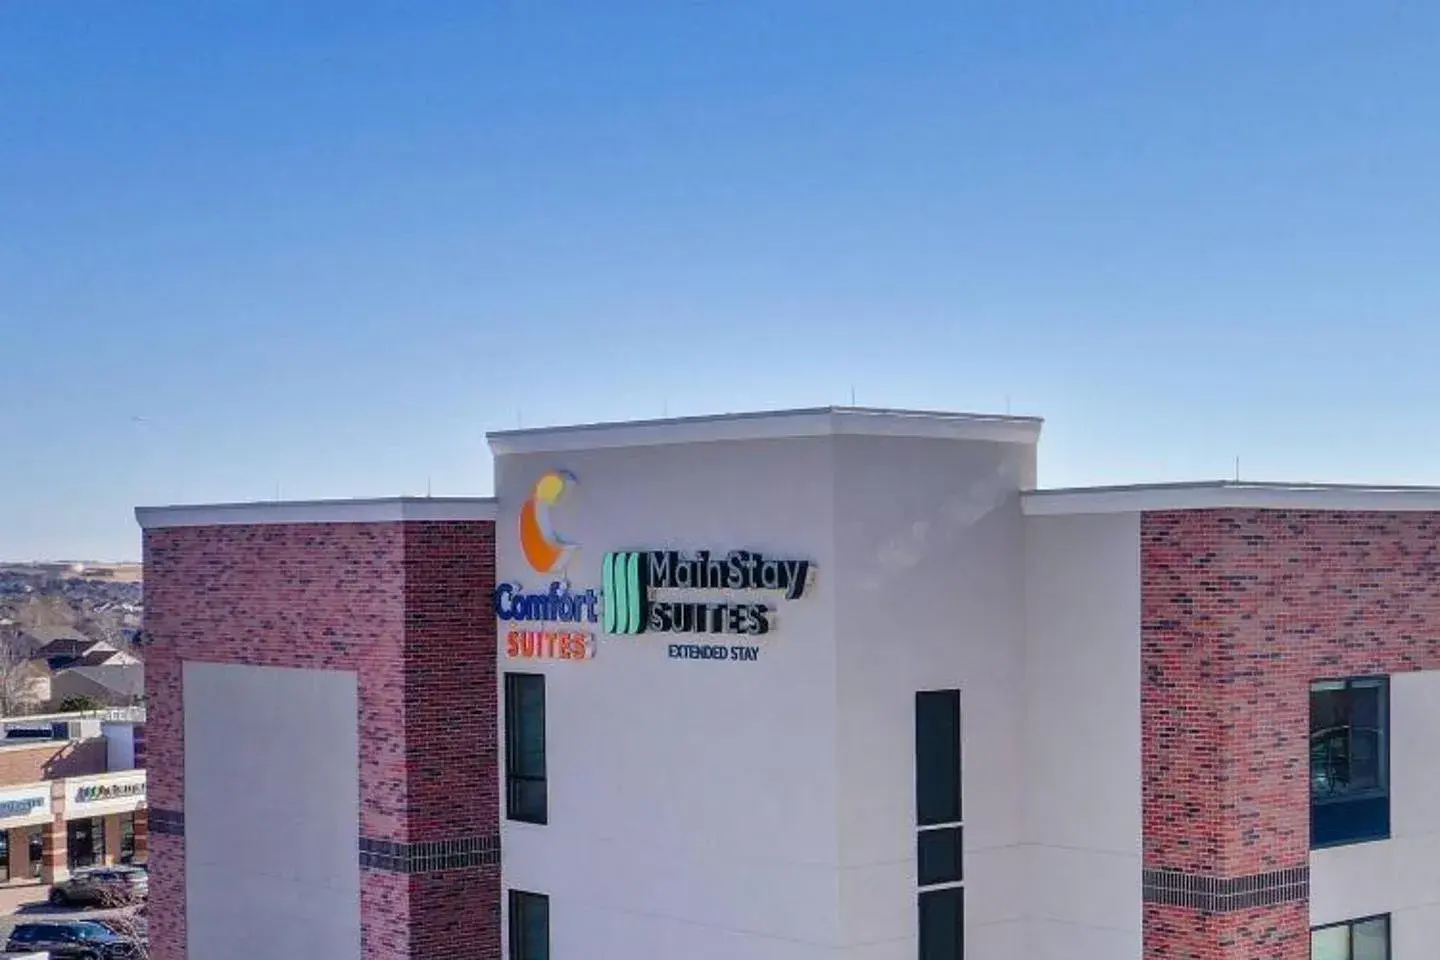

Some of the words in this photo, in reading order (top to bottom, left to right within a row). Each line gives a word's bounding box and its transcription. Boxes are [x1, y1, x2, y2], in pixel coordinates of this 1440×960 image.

[650, 552, 809, 600] MainStay
[495, 582, 598, 623] Comfort
[651, 604, 769, 634] SUITES
[507, 631, 588, 660] SUITES
[669, 645, 728, 660] EXTENDED
[731, 645, 759, 661] STAY
